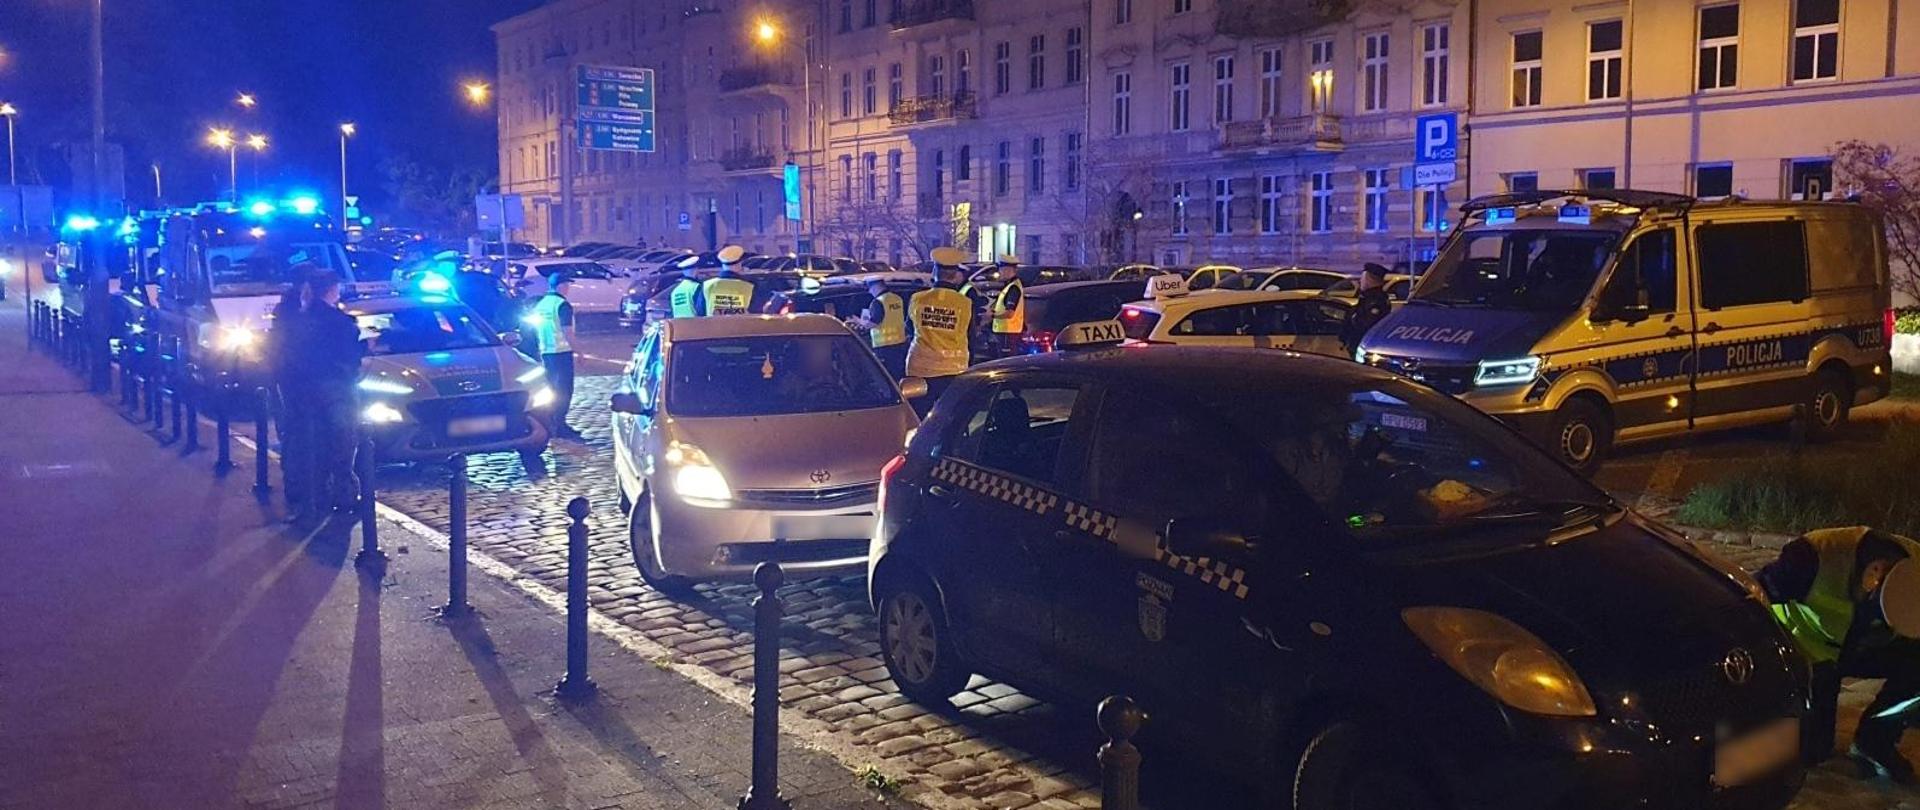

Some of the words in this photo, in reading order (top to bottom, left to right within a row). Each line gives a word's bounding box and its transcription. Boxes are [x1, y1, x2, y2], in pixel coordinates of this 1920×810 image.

[1425, 119, 1448, 157] P
[1155, 280, 1180, 291] Uber
[1080, 324, 1121, 341] TAXI
[1386, 326, 1474, 344] POLICJA
[1726, 340, 1782, 367] POLICJA
